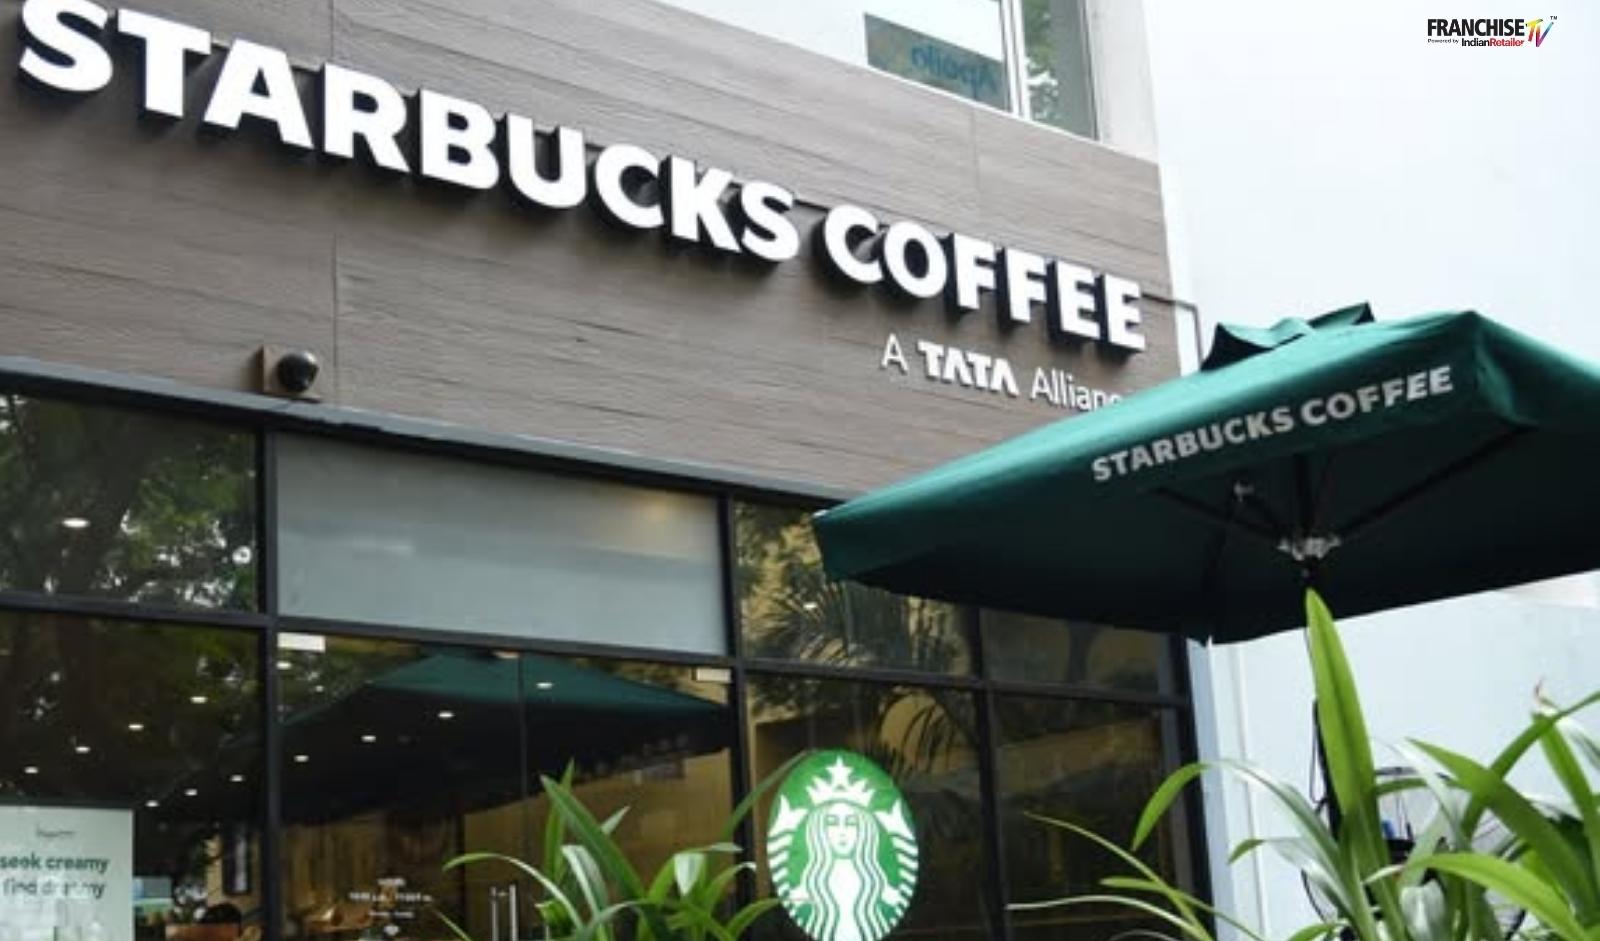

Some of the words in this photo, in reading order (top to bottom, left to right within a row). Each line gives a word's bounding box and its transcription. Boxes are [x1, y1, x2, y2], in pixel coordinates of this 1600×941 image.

[20, 0, 799, 263] STARBUCKS
[824, 204, 1146, 352] COFFEE
[881, 333, 908, 373] A
[917, 340, 1020, 396] TATA
[1030, 366, 1121, 411] Allian
[1091, 406, 1294, 482] STARBUCKS
[1300, 365, 1453, 426] COFFEE
